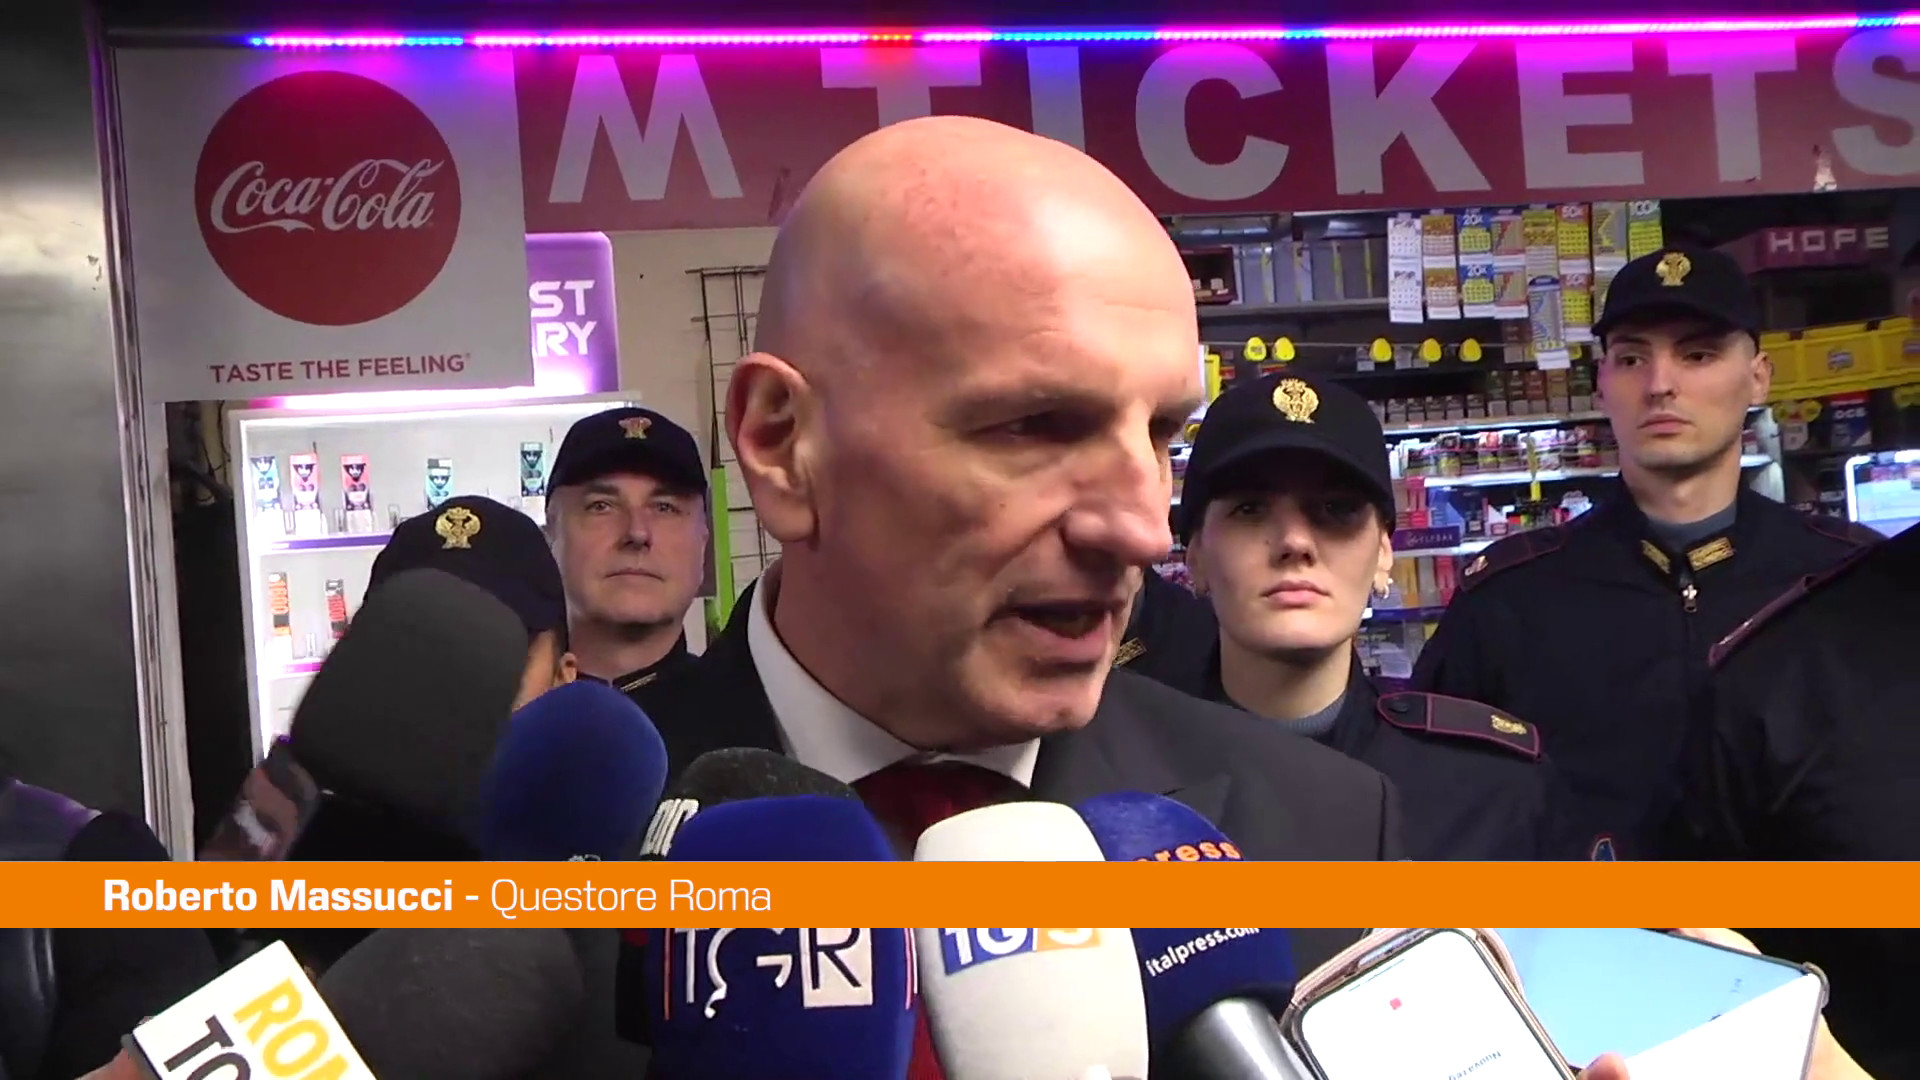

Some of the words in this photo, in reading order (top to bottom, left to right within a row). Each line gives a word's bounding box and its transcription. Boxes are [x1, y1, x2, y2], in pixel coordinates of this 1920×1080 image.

[820, 28, 1920, 200] TICKETS
[211, 158, 444, 233] Coca-Cola
[1769, 226, 1889, 252] HOPE
[531, 321, 597, 357] RY
[210, 362, 293, 383] TASTE
[300, 359, 350, 379] THE
[1137, 842, 1241, 861] ress
[1146, 928, 1259, 977] italpress.com
